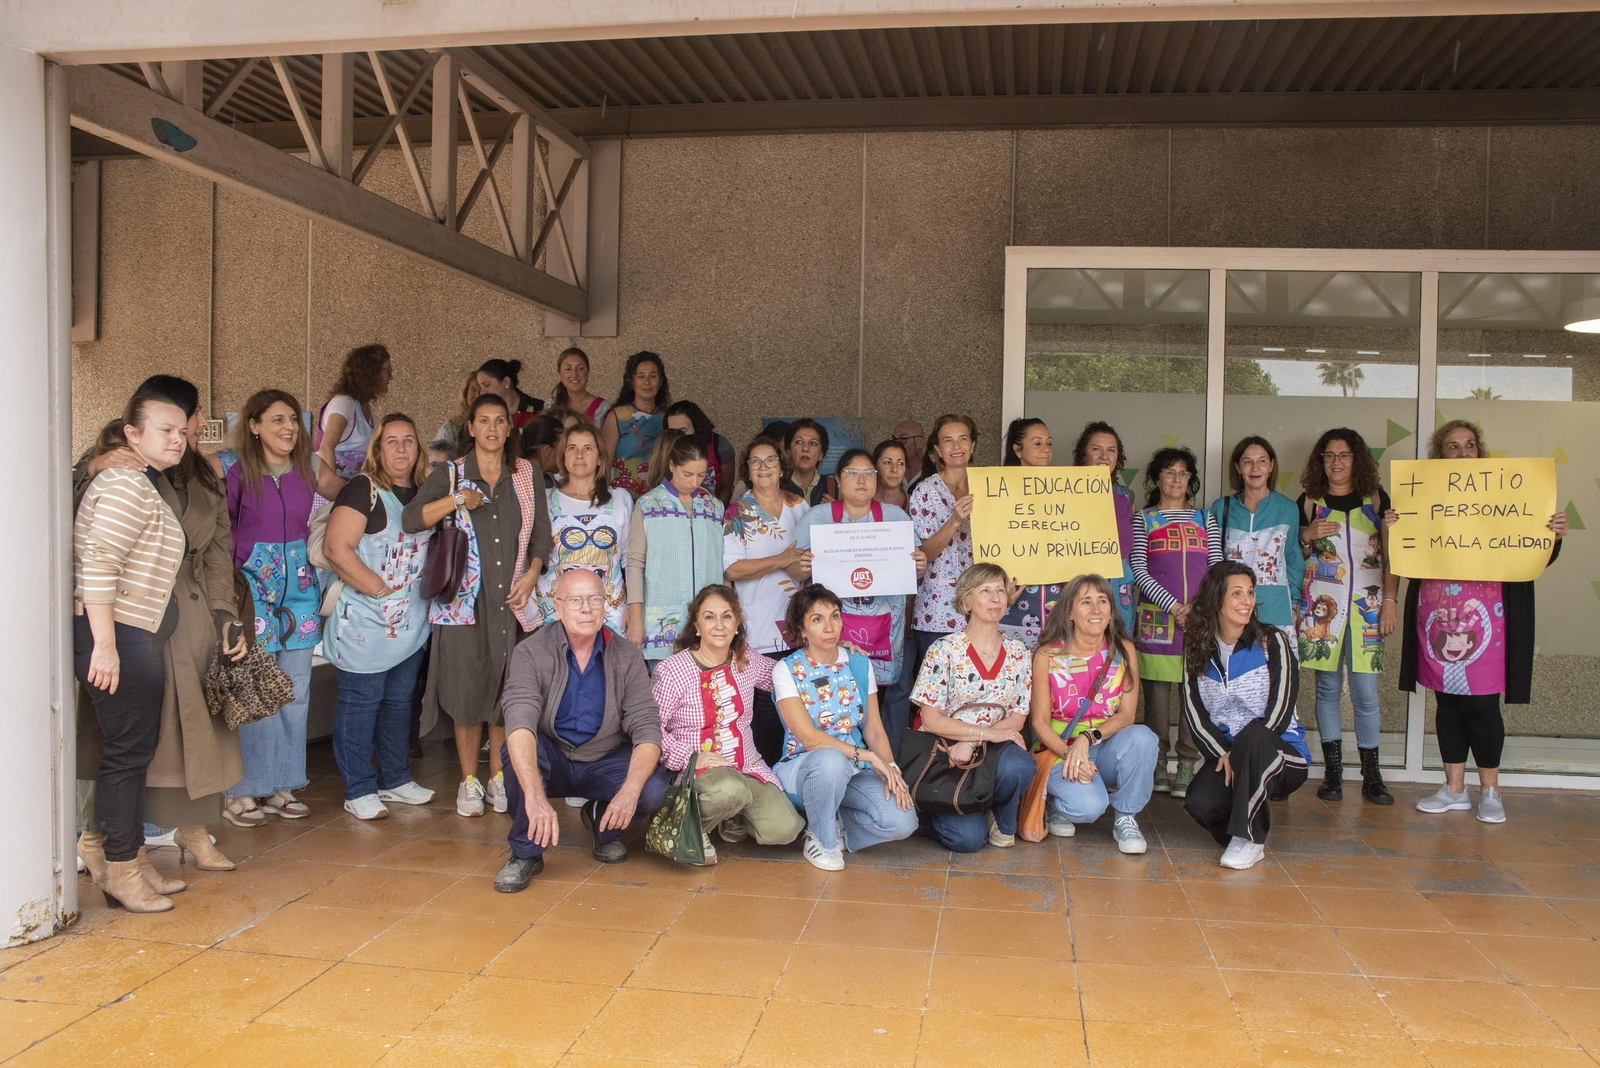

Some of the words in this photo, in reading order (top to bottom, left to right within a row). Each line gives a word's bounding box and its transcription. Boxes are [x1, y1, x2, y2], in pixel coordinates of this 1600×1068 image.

[986, 476, 1009, 498] LA
[1014, 503, 1035, 516] ES
[1044, 503, 1065, 516] UN
[1430, 503, 1534, 520] PERSONAL
[1007, 520, 1080, 531] DERECHO
[1430, 534, 1482, 549] MALA
[1488, 534, 1552, 550] CALIDAD
[979, 543, 1001, 558] NO
[1012, 542, 1039, 557] UN
[853, 570, 871, 581] UGT
[833, 674, 849, 683] OWL
